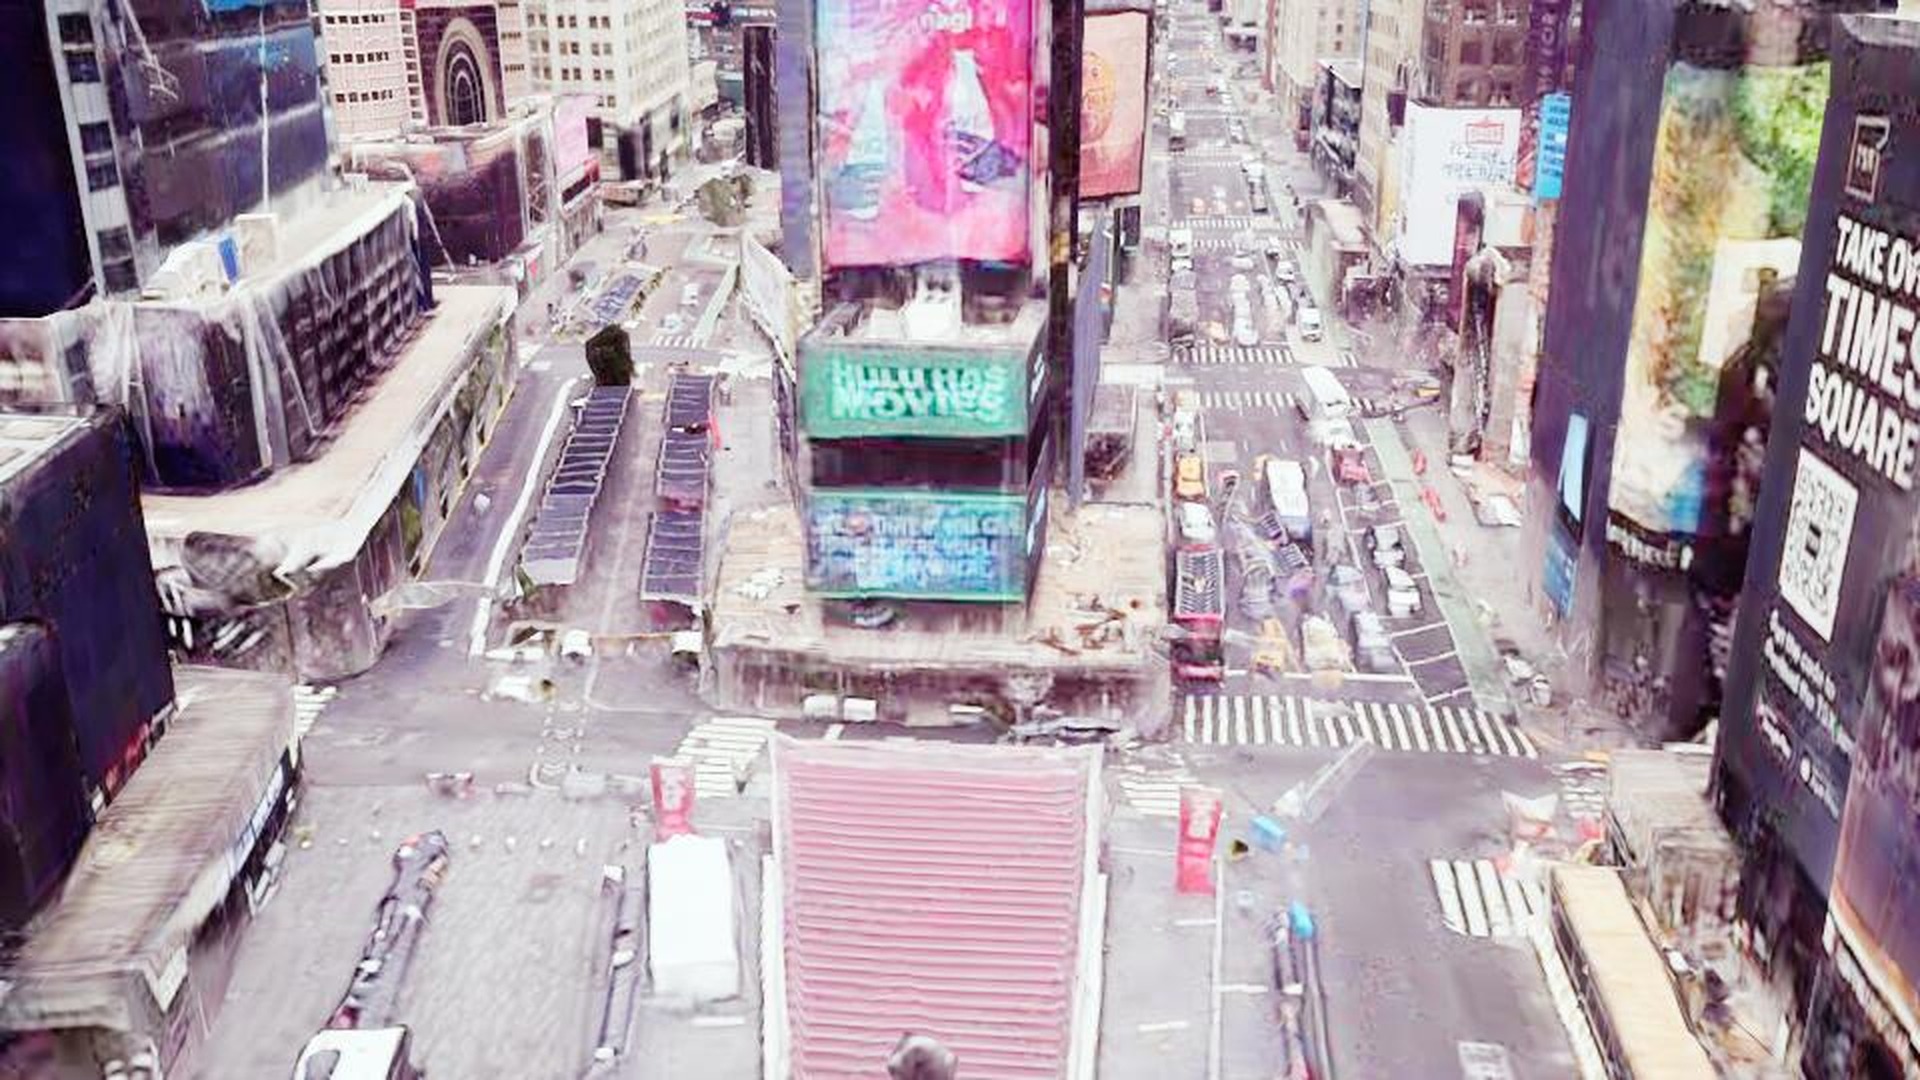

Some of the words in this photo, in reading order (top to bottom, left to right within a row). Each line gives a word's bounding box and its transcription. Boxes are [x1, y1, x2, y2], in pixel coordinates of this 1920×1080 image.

[1836, 214, 1889, 285] TAKE
[1887, 237, 1920, 299] OV
[1821, 272, 1920, 411] TIMES
[1805, 362, 1919, 491] SQUARE
